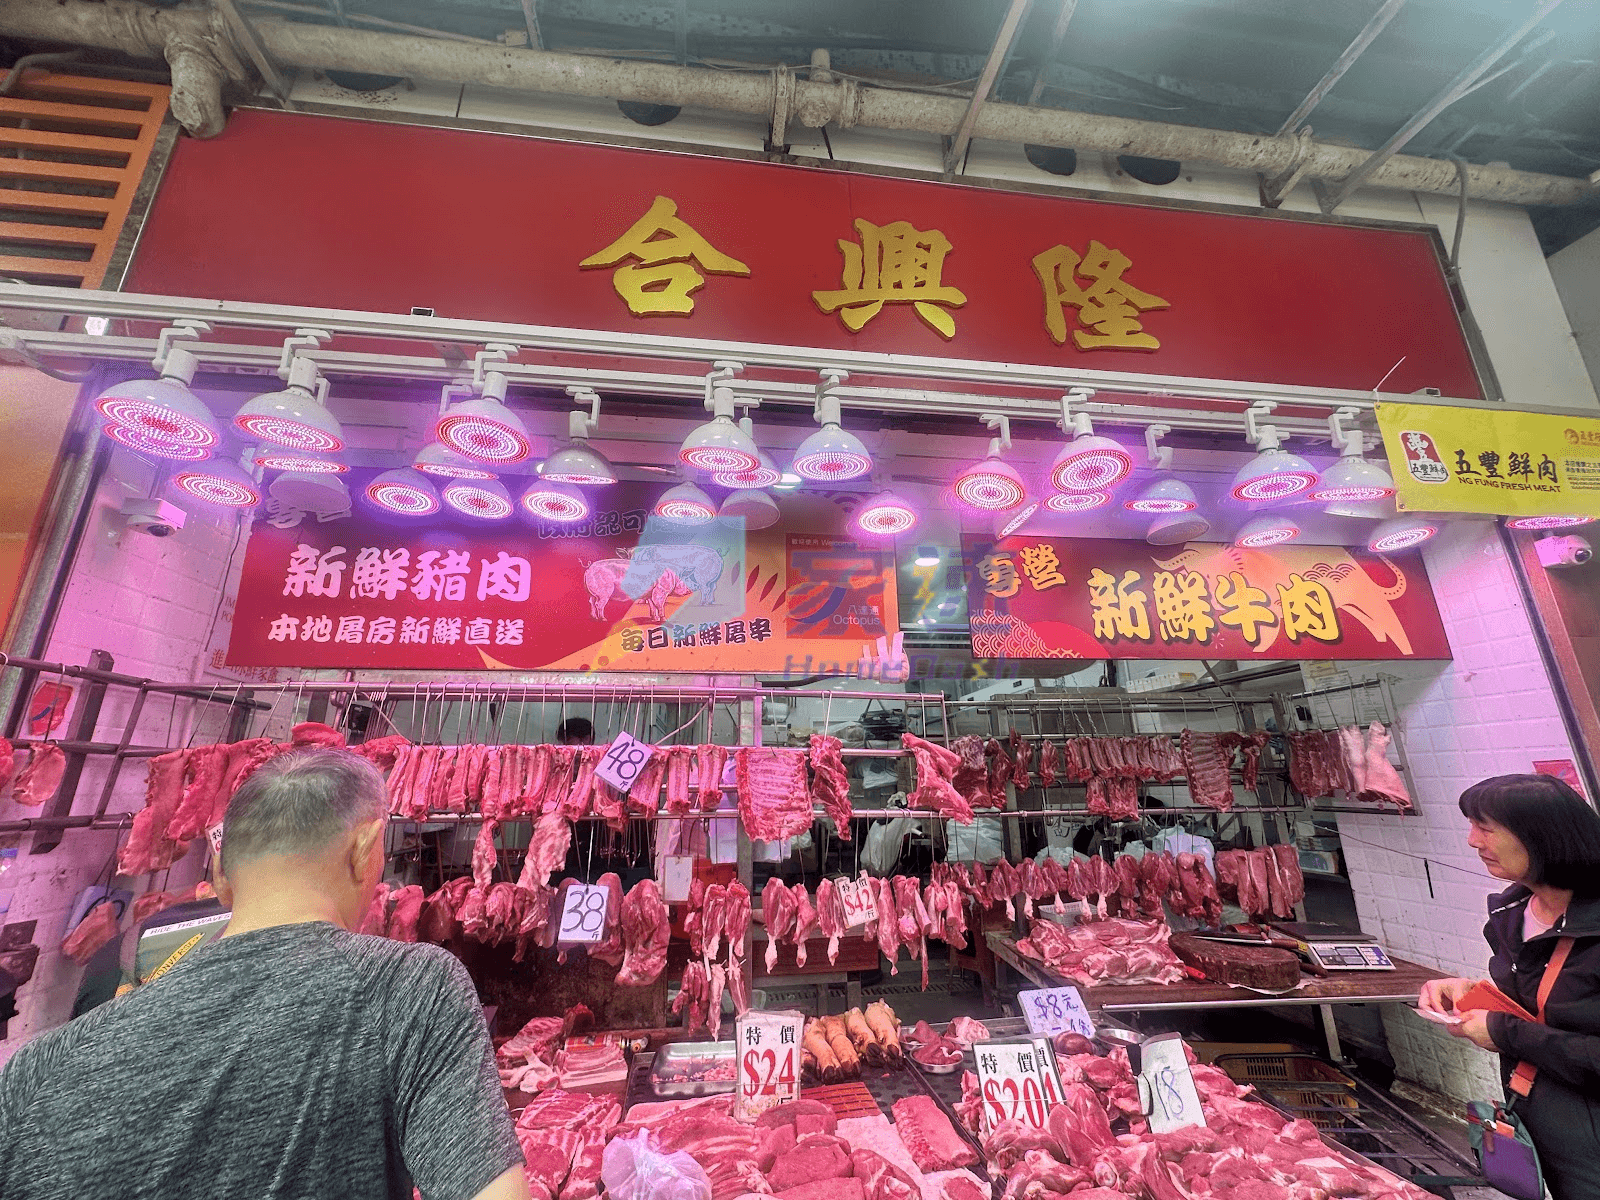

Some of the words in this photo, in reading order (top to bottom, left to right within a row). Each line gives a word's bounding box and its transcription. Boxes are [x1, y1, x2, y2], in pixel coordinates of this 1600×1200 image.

[579, 195, 1171, 353] 合興隆
[1454, 449, 1558, 483] 五豐鮮肉
[1474, 478, 1500, 488] FUNG
[1500, 481, 1533, 491] FRESH
[1533, 484, 1561, 493] MEAT
[283, 544, 532, 601] 新鮮豬肉
[833, 614, 880, 626] Octopus
[1089, 567, 1342, 643] 新鮮牛肉
[267, 613, 525, 645] 本地屠房新鮮直送
[620, 617, 772, 652] 每日新鮮屠宰
[607, 741, 645, 780] 48
[562, 890, 605, 932] 38
[844, 888, 874, 916] $42
[150, 924, 174, 935] RIDE
[177, 920, 195, 929] THE
[197, 913, 231, 925] WAVES
[746, 1025, 796, 1046] 特價
[743, 1048, 796, 1100] $24
[980, 1051, 1035, 1075] 特價
[983, 1077, 1045, 1129] $20
